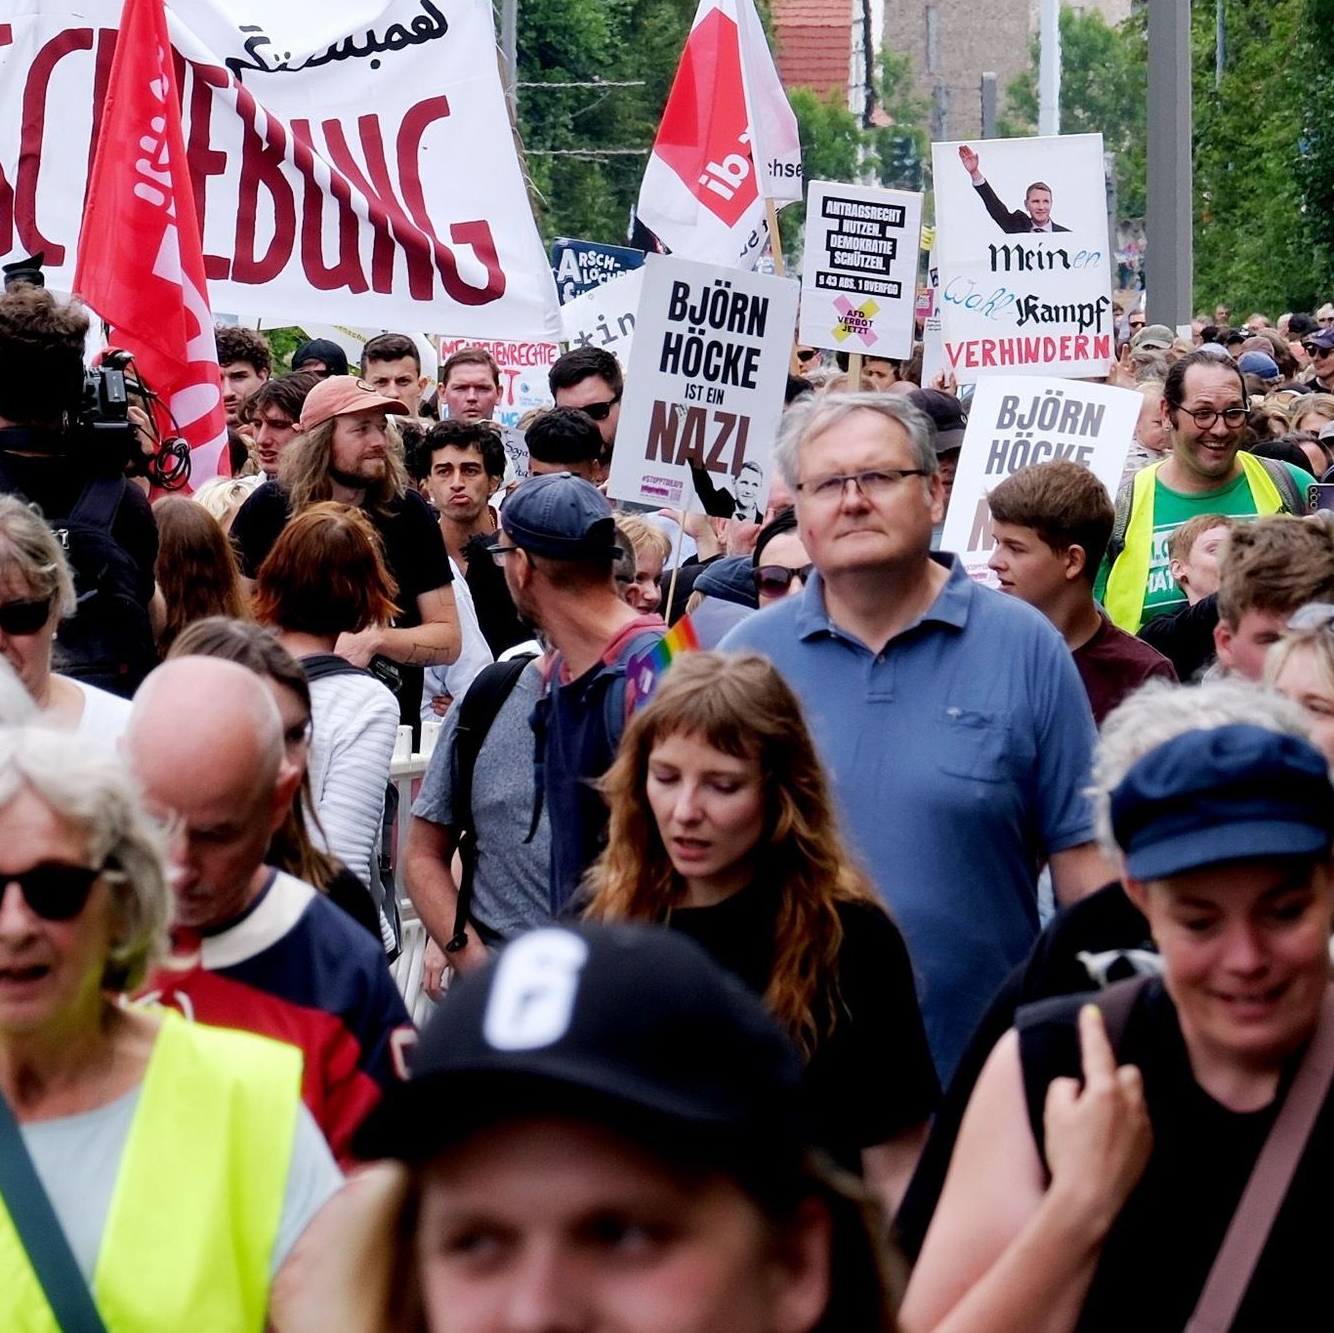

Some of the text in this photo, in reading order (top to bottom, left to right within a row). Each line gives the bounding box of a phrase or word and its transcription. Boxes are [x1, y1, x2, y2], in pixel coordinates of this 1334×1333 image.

[826, 201, 901, 223] ANTRAGSRECHT
[843, 219, 882, 236] NUTZEN.
[830, 234, 893, 255] DEMOKRATIE
[834, 251, 886, 270] SCHÜTZEN.
[826, 275, 838, 286] 43
[839, 277, 856, 289] ABS.
[858, 279, 863, 290] 1
[667, 279, 769, 338] BJÖRN
[846, 309, 865, 318] AFD
[838, 316, 874, 327] VERBOT
[842, 325, 869, 335] JETZT
[659, 326, 761, 389] HÖCKE
[945, 334, 1110, 369] VERHINDERN
[684, 383, 725, 405] IST EIN
[995, 389, 1106, 438] BJÖRN
[645, 400, 750, 476] NAZI
